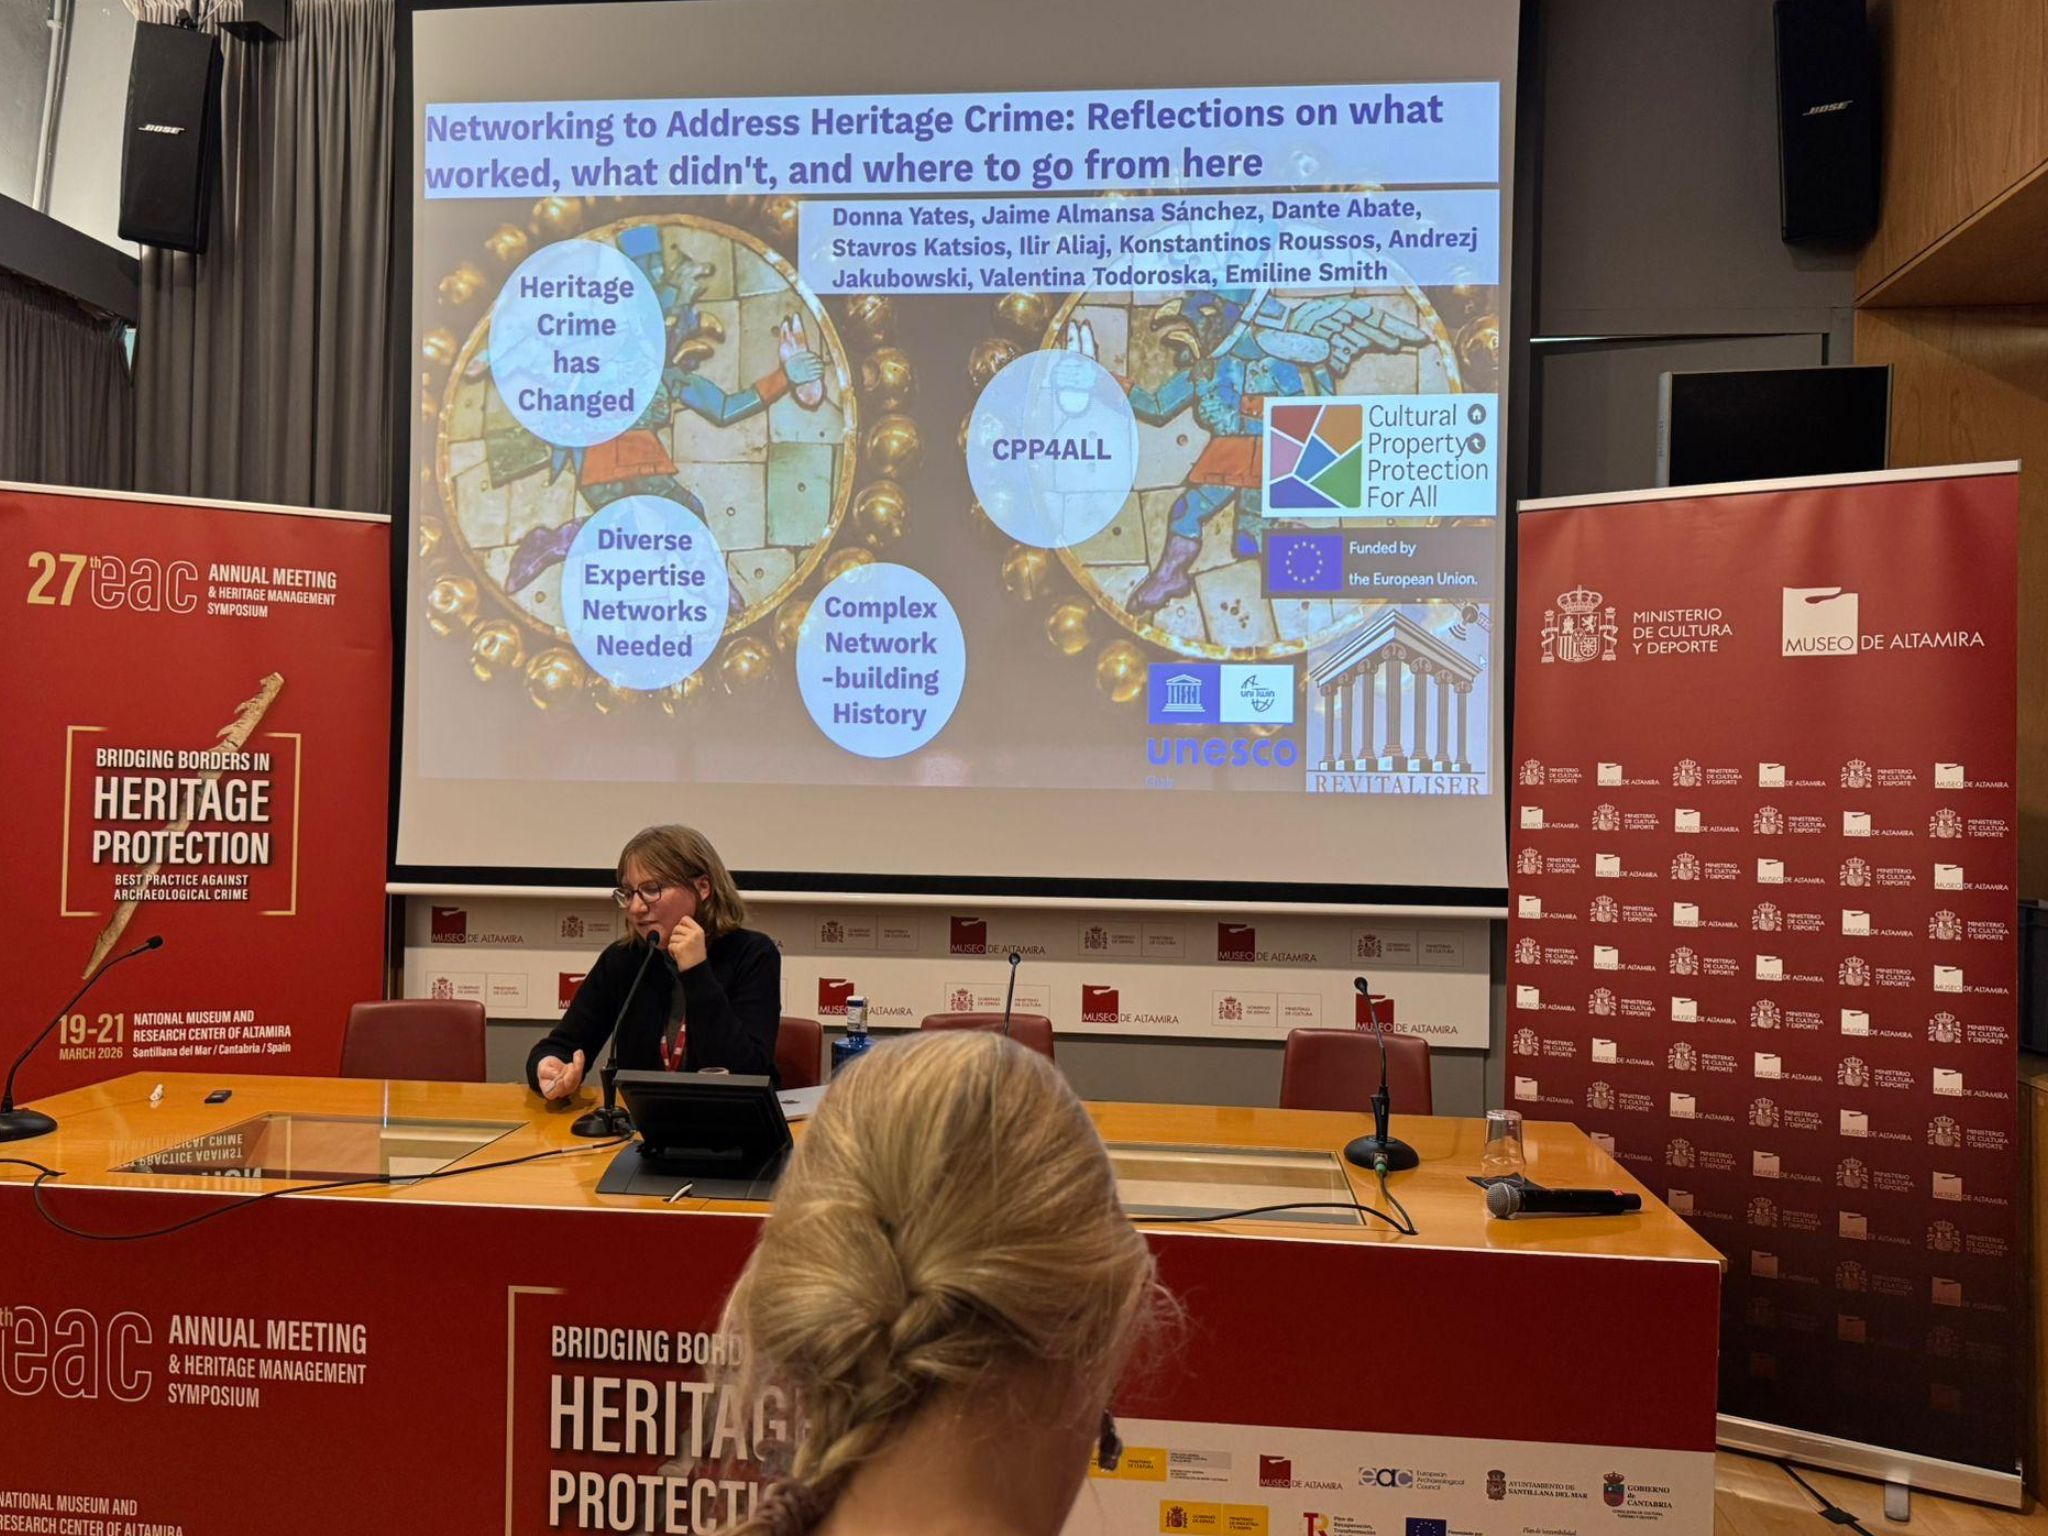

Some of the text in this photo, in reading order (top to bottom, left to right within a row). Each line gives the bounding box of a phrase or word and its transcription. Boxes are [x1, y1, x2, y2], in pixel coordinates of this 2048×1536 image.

[426, 93, 1444, 147] Networking to Address Heritage Crime: Reflections on what
[425, 147, 1263, 192] worked, what didn't, and where to go from here
[832, 198, 1422, 229] Donna Yates, Jaime Almansa Sánchez, Dante Abate,
[832, 227, 1478, 260] Stavros Katsios, Ilir Aliaj, Konstantinos Roussos, Andrezj
[832, 260, 1388, 291] Jakubowski, Valentina Todoroska, Emiline Smith
[519, 274, 634, 304] Heritage
[536, 313, 617, 337] Crime
[553, 349, 601, 375] has
[517, 387, 635, 418] Changed
[1368, 403, 1457, 427] Cultural
[992, 438, 1112, 461] CPP4ALL
[1368, 432, 1468, 459] Property
[1368, 459, 1489, 482] Protection
[1367, 485, 1438, 508] For All
[598, 527, 693, 551] Diverse
[1348, 540, 1417, 558] Funded by
[91, 555, 199, 614] eac
[208, 563, 337, 590] ANNUAL MEETING
[583, 563, 706, 592] Expertise
[1348, 572, 1479, 589] the European Union.
[207, 585, 337, 606] & HERITAGE MANAGEMENT
[207, 602, 268, 618] SYMPOSIUM
[582, 598, 708, 623] Networks
[823, 595, 938, 624] Complex
[1632, 607, 1723, 622] MINISTERIO
[824, 630, 938, 654] Network
[1632, 623, 1733, 640] DE CULTURA
[1785, 631, 1985, 653] MUSEO DE ALTAMIRA
[596, 634, 693, 657] Needed
[1632, 639, 1719, 655] Y DEPORTE
[822, 665, 940, 696] -building
[832, 701, 927, 731] History
[96, 748, 270, 772] BRIDGING BORDERS IN
[1147, 737, 1298, 768] unesco
[1315, 775, 1481, 795] REVITALISER
[93, 776, 270, 823] HERITAGE
[92, 829, 269, 865] PROTECTION
[115, 874, 249, 886] BEST PRACTICE AGAINST
[114, 888, 249, 901] ARCHAEOLOGICAL CRIME
[432, 932, 524, 944] MUSEO DE ALTAMIRA
[58, 1013, 125, 1045] 19-21
[134, 1010, 255, 1026] NATIONAL MUSEUM AND
[1082, 1012, 1179, 1024] MUSEO DE ALTAMIRA
[133, 1024, 292, 1043] RESEARCH CENTER OF ALTAMIRA
[59, 1046, 123, 1060] MARCH 2026
[133, 1042, 291, 1059] Santillana del Mar Cantabria Spain
[168, 1314, 367, 1355] ANNUAL MEETING
[551, 1325, 745, 1367] BRIDGING BORD
[1, 1305, 153, 1402] eac
[168, 1353, 367, 1384] & HERITAGE MANAGEMENT
[168, 1383, 260, 1408] SYMPOSIUM
[1304, 1481, 1343, 1490] ALTAMIRA
[1509, 1481, 1564, 1490] AYUNTAMIENTO
[1509, 1489, 1553, 1498] SANTILLANA
[1627, 1484, 1670, 1494] GOBIERNO
[57, 1494, 109, 1515] MUSEUM
[112, 1498, 138, 1516] AND
[549, 1469, 760, 1536] PROTECTI
[1627, 1500, 1672, 1509] CANTABRIA
[60, 1517, 103, 1536] CENTER
[107, 1520, 121, 1536] OF
